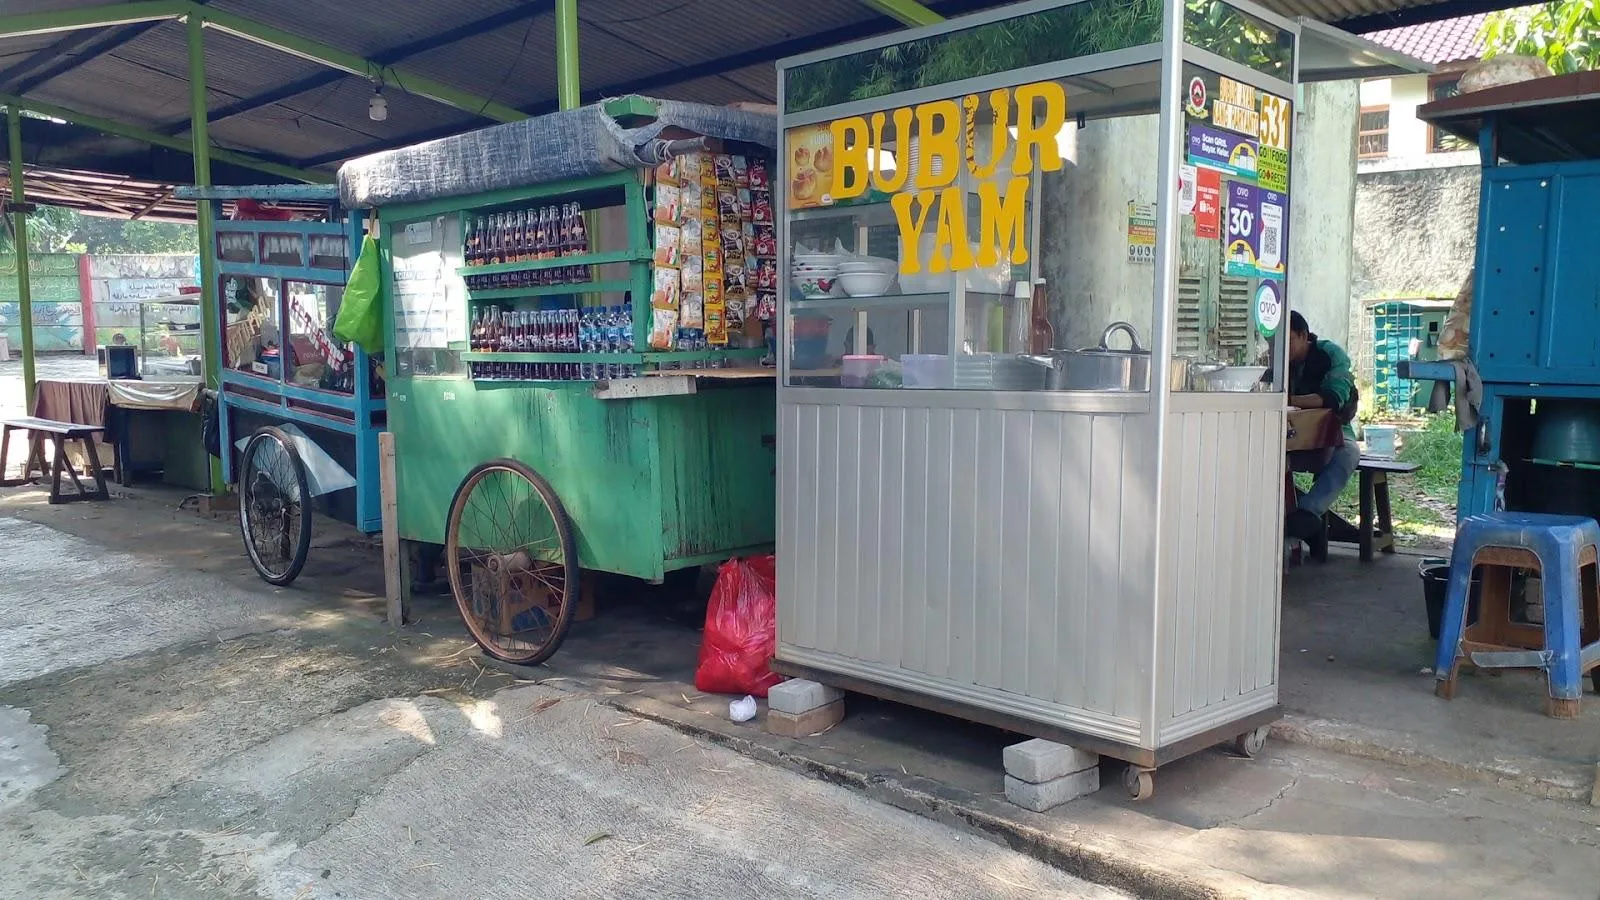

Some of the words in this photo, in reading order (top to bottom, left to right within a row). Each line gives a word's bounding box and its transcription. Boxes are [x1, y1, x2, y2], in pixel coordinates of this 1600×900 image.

[1260, 95, 1289, 149] 531
[829, 81, 1067, 200] BUBUR
[1202, 133, 1214, 143] Scan
[1259, 146, 1267, 158] GO
[1271, 149, 1288, 164] FOOD
[1271, 170, 1287, 185] RESTO
[1236, 186, 1249, 197] OVO
[1267, 192, 1278, 201] OVO
[891, 177, 1030, 275] YAM
[1260, 302, 1277, 315] OVO
